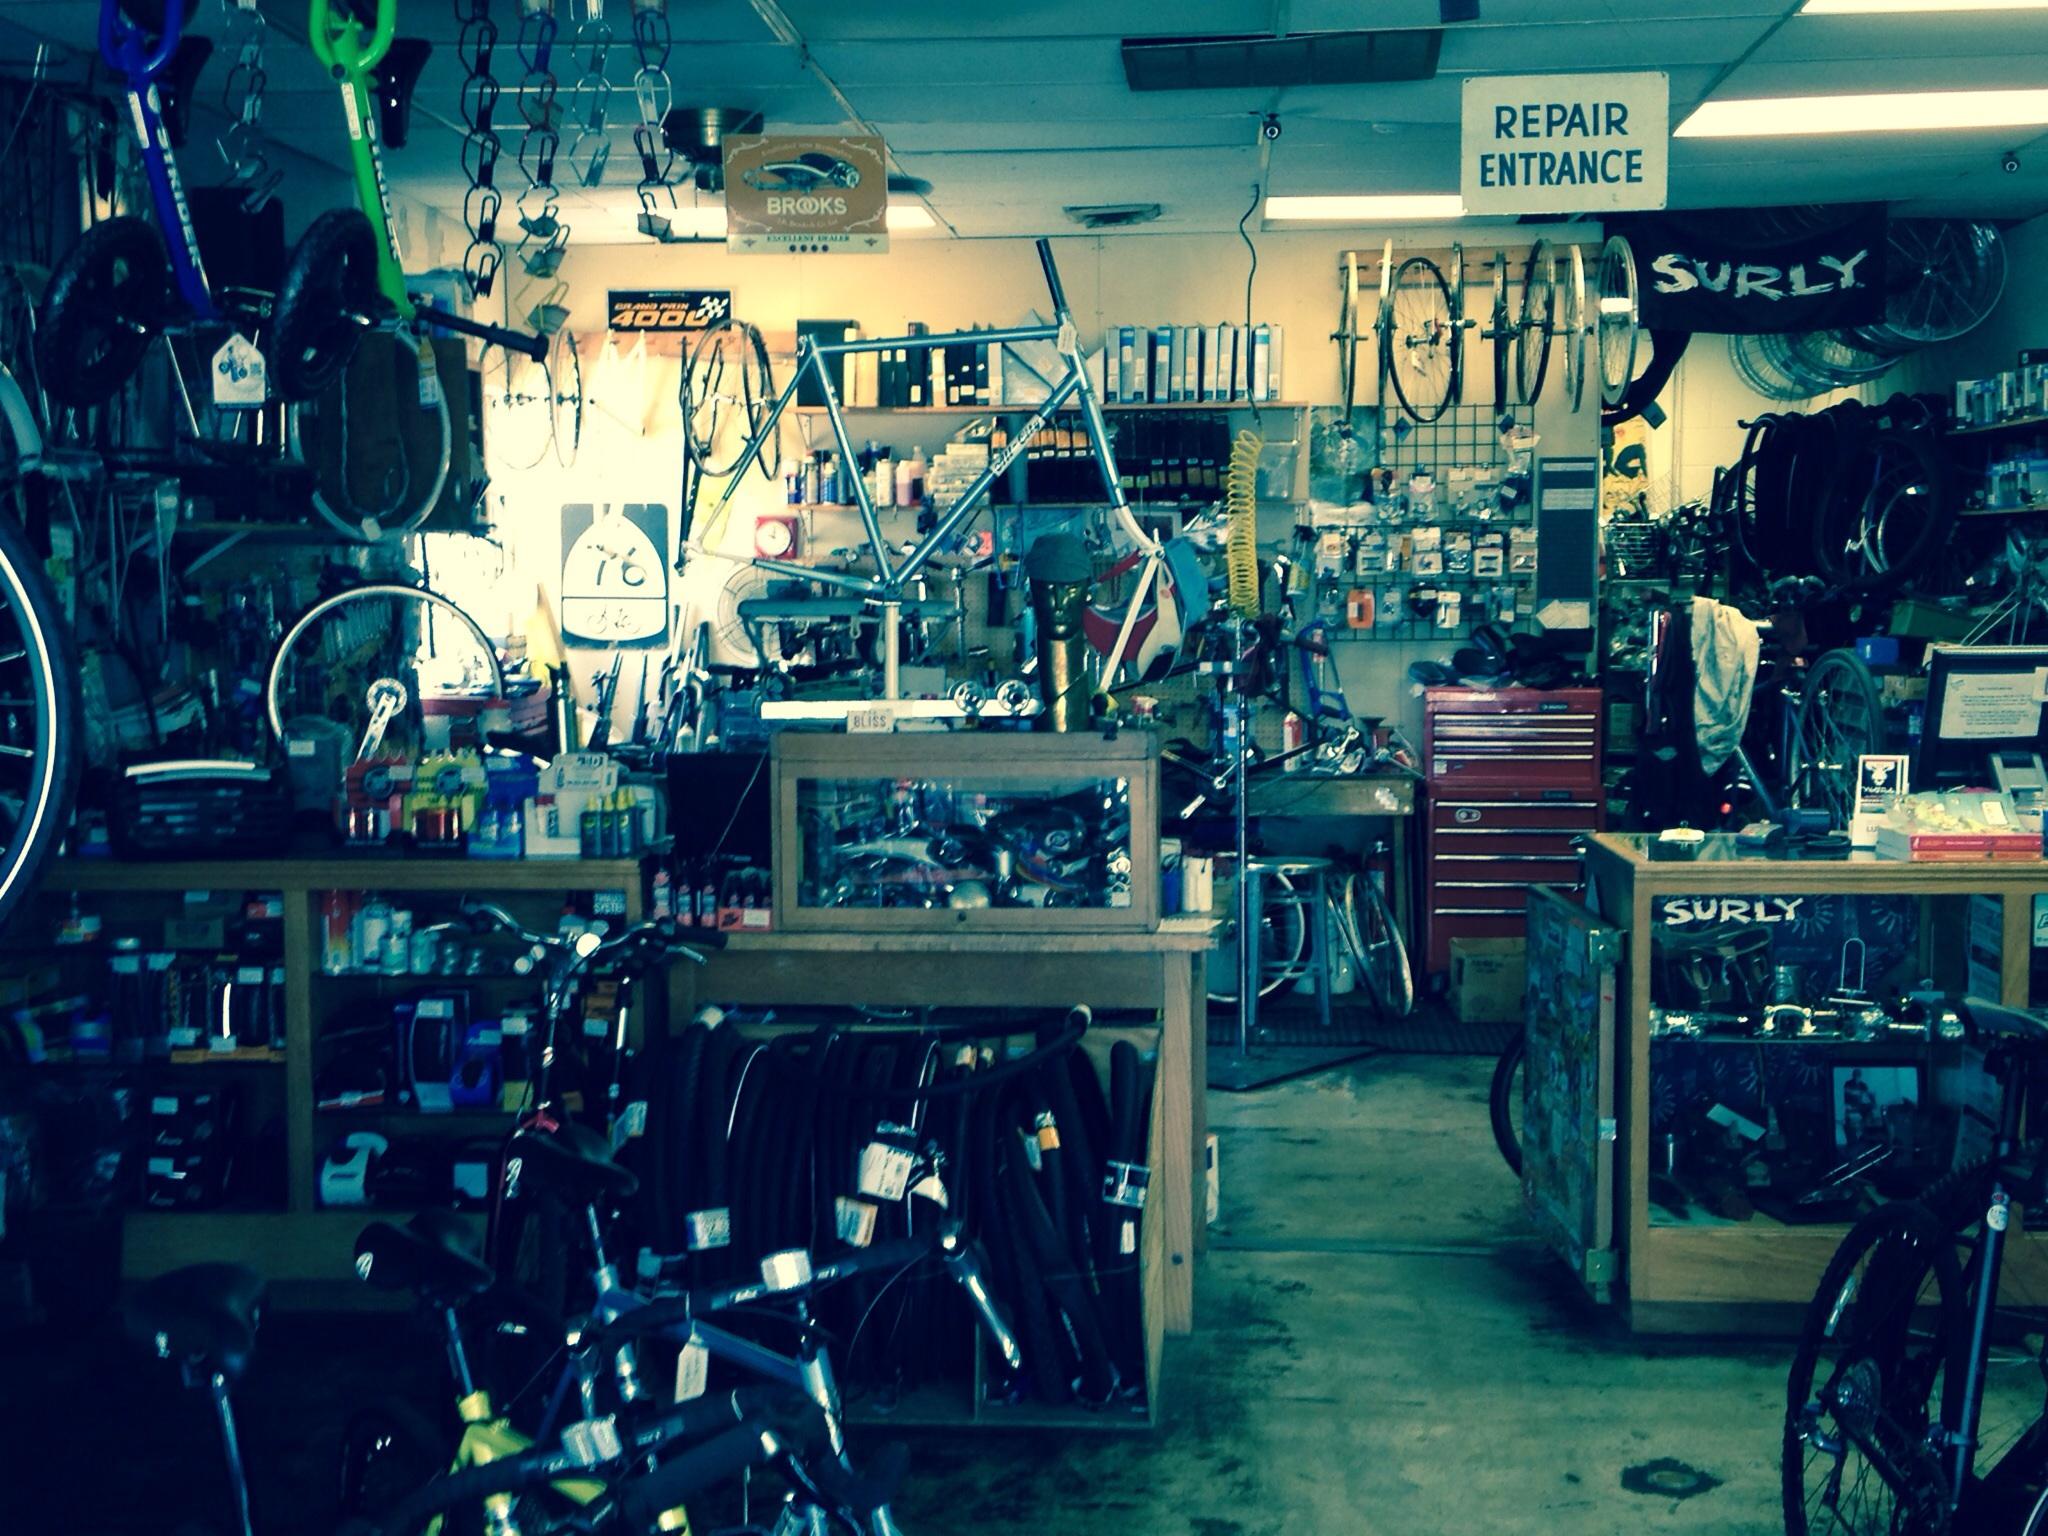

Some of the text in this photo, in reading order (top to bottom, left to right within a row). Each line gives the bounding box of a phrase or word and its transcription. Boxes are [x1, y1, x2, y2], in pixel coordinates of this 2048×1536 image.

[1495, 102, 1628, 139] REPAIR
[1480, 149, 1643, 187] ENTRANCE
[767, 197, 848, 215] BROOKS
[1651, 249, 1869, 302] SURLY
[614, 302, 690, 310] GRAND PRIX
[853, 715, 887, 728] BLISS
[1663, 897, 1804, 925] SURLY
